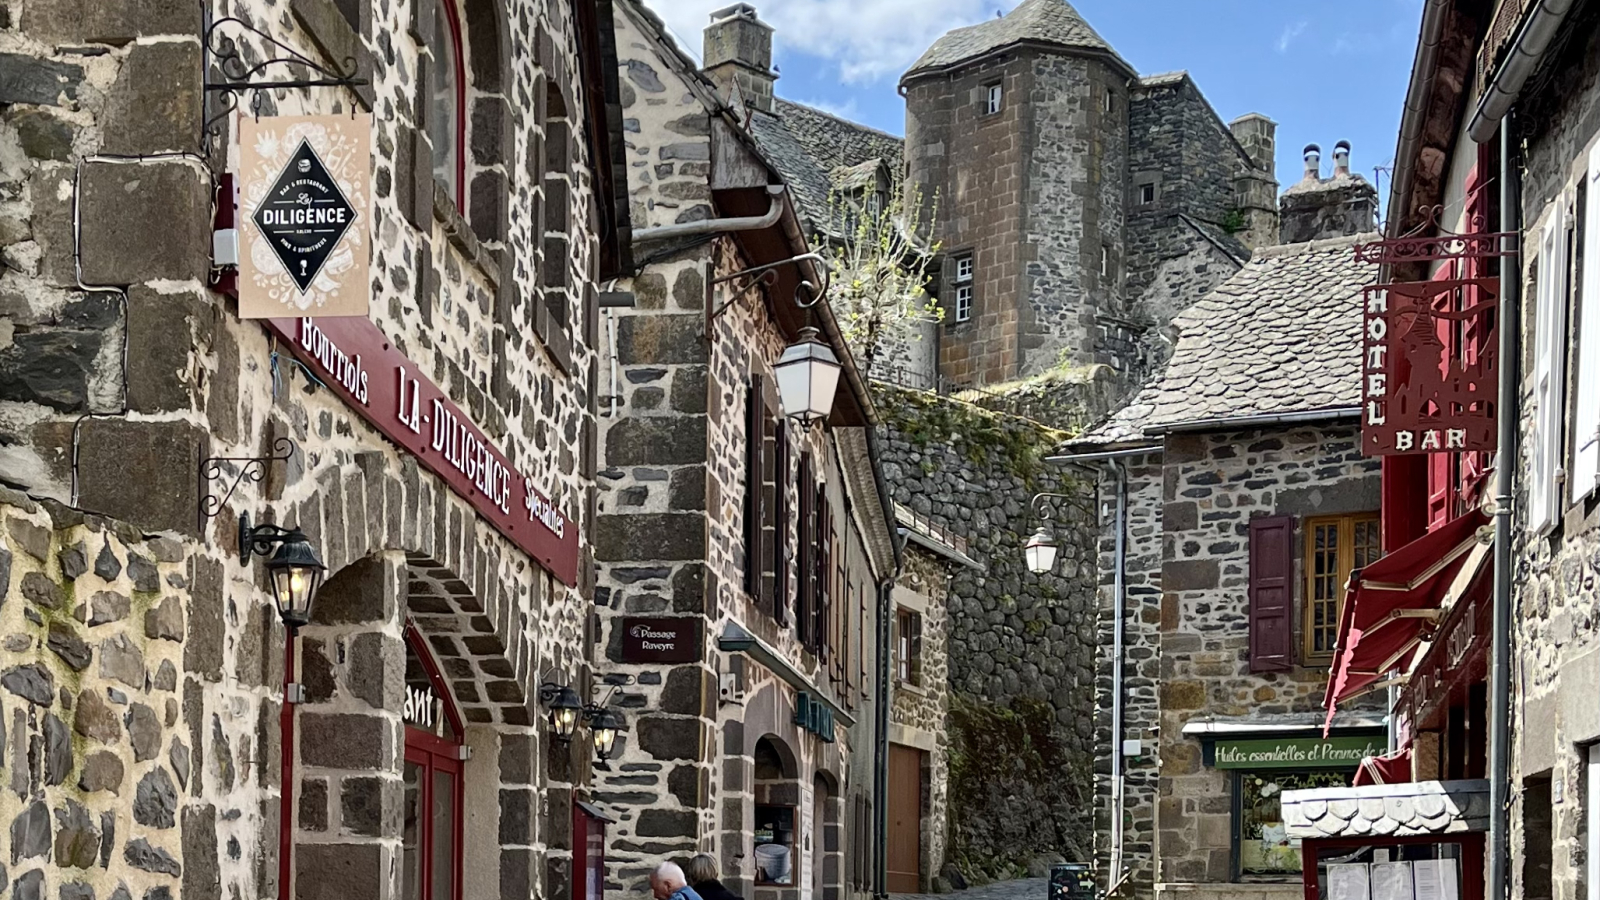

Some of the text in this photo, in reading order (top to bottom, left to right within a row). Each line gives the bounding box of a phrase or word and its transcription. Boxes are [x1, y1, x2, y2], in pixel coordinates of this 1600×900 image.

[263, 208, 346, 225] DILIGENCE
[301, 317, 368, 404] Bourriols
[1367, 288, 1389, 426] HOTEL
[1395, 428, 1466, 451] BAR
[641, 629, 676, 640] Passage
[642, 640, 675, 651] Raveyre
[1214, 746, 1247, 762] Huiles
[1249, 744, 1306, 762] essentielles
[1307, 743, 1320, 760] et
[1322, 743, 1362, 760] Pommes
